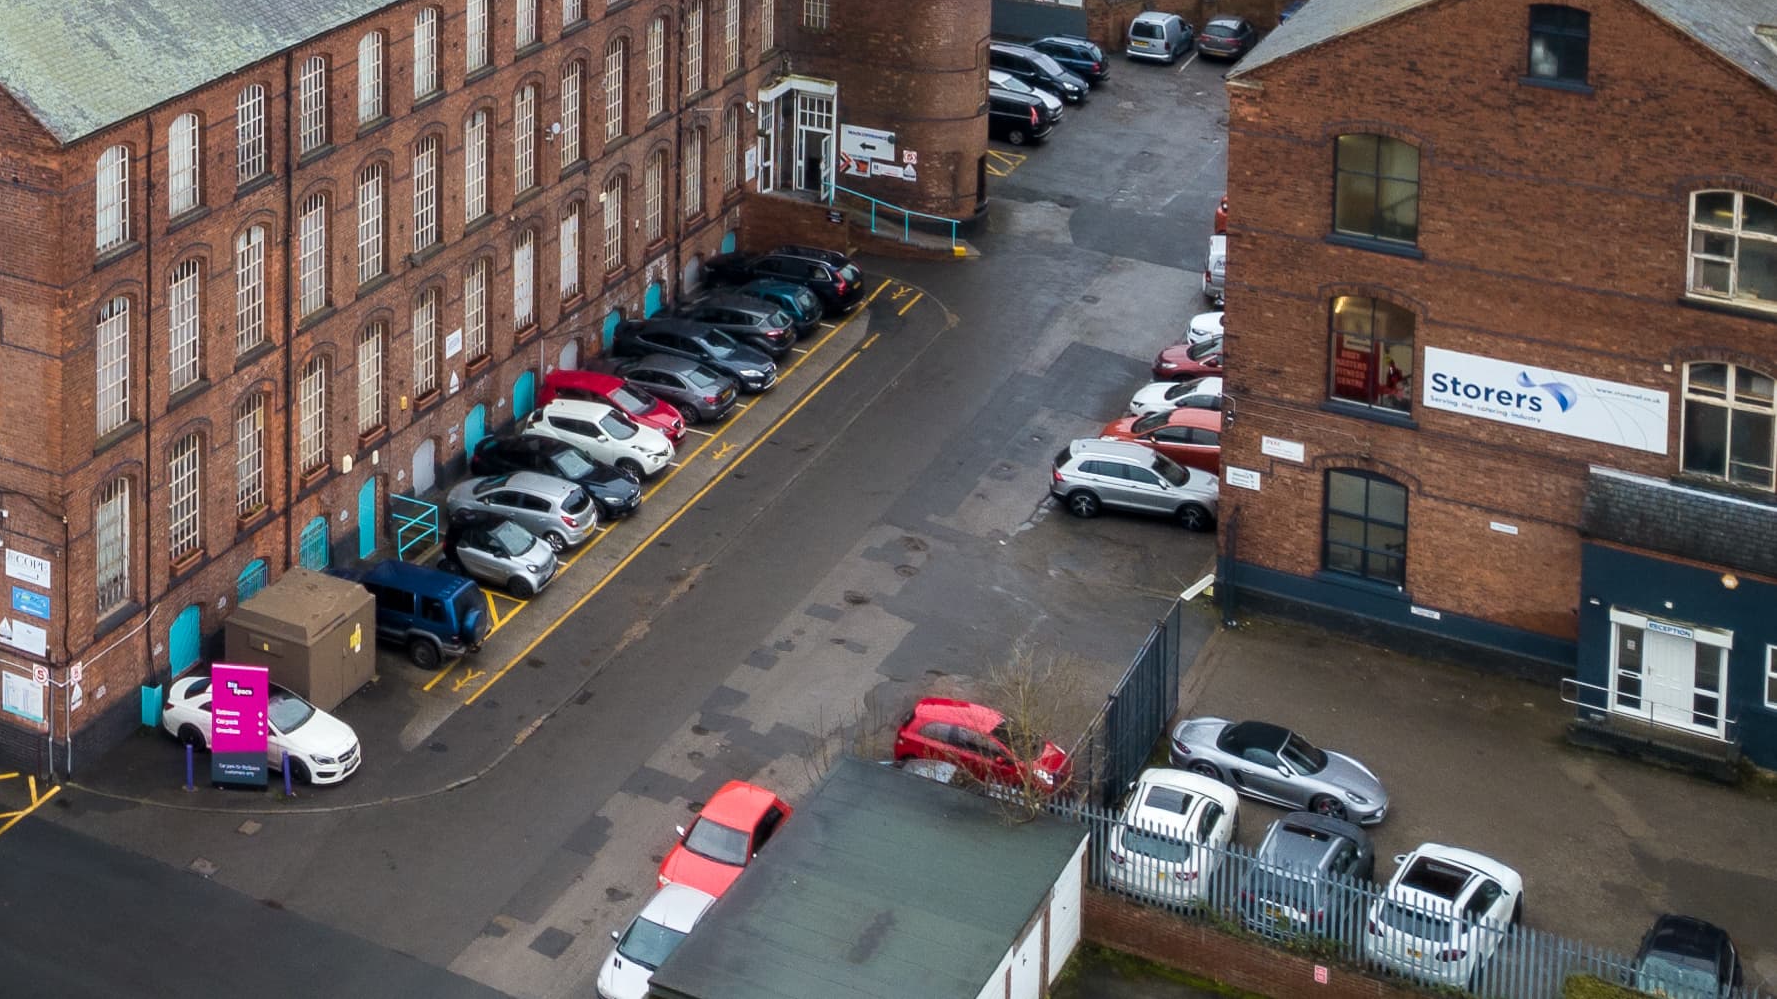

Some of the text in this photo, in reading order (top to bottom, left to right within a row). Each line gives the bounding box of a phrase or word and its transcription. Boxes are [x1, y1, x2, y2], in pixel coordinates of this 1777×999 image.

[1431, 372, 1543, 413] Storers
[1430, 395, 1458, 407] Serving
[1477, 406, 1508, 417] catering
[1511, 411, 1541, 423] industry
[1649, 622, 1691, 637] RECEPTION
